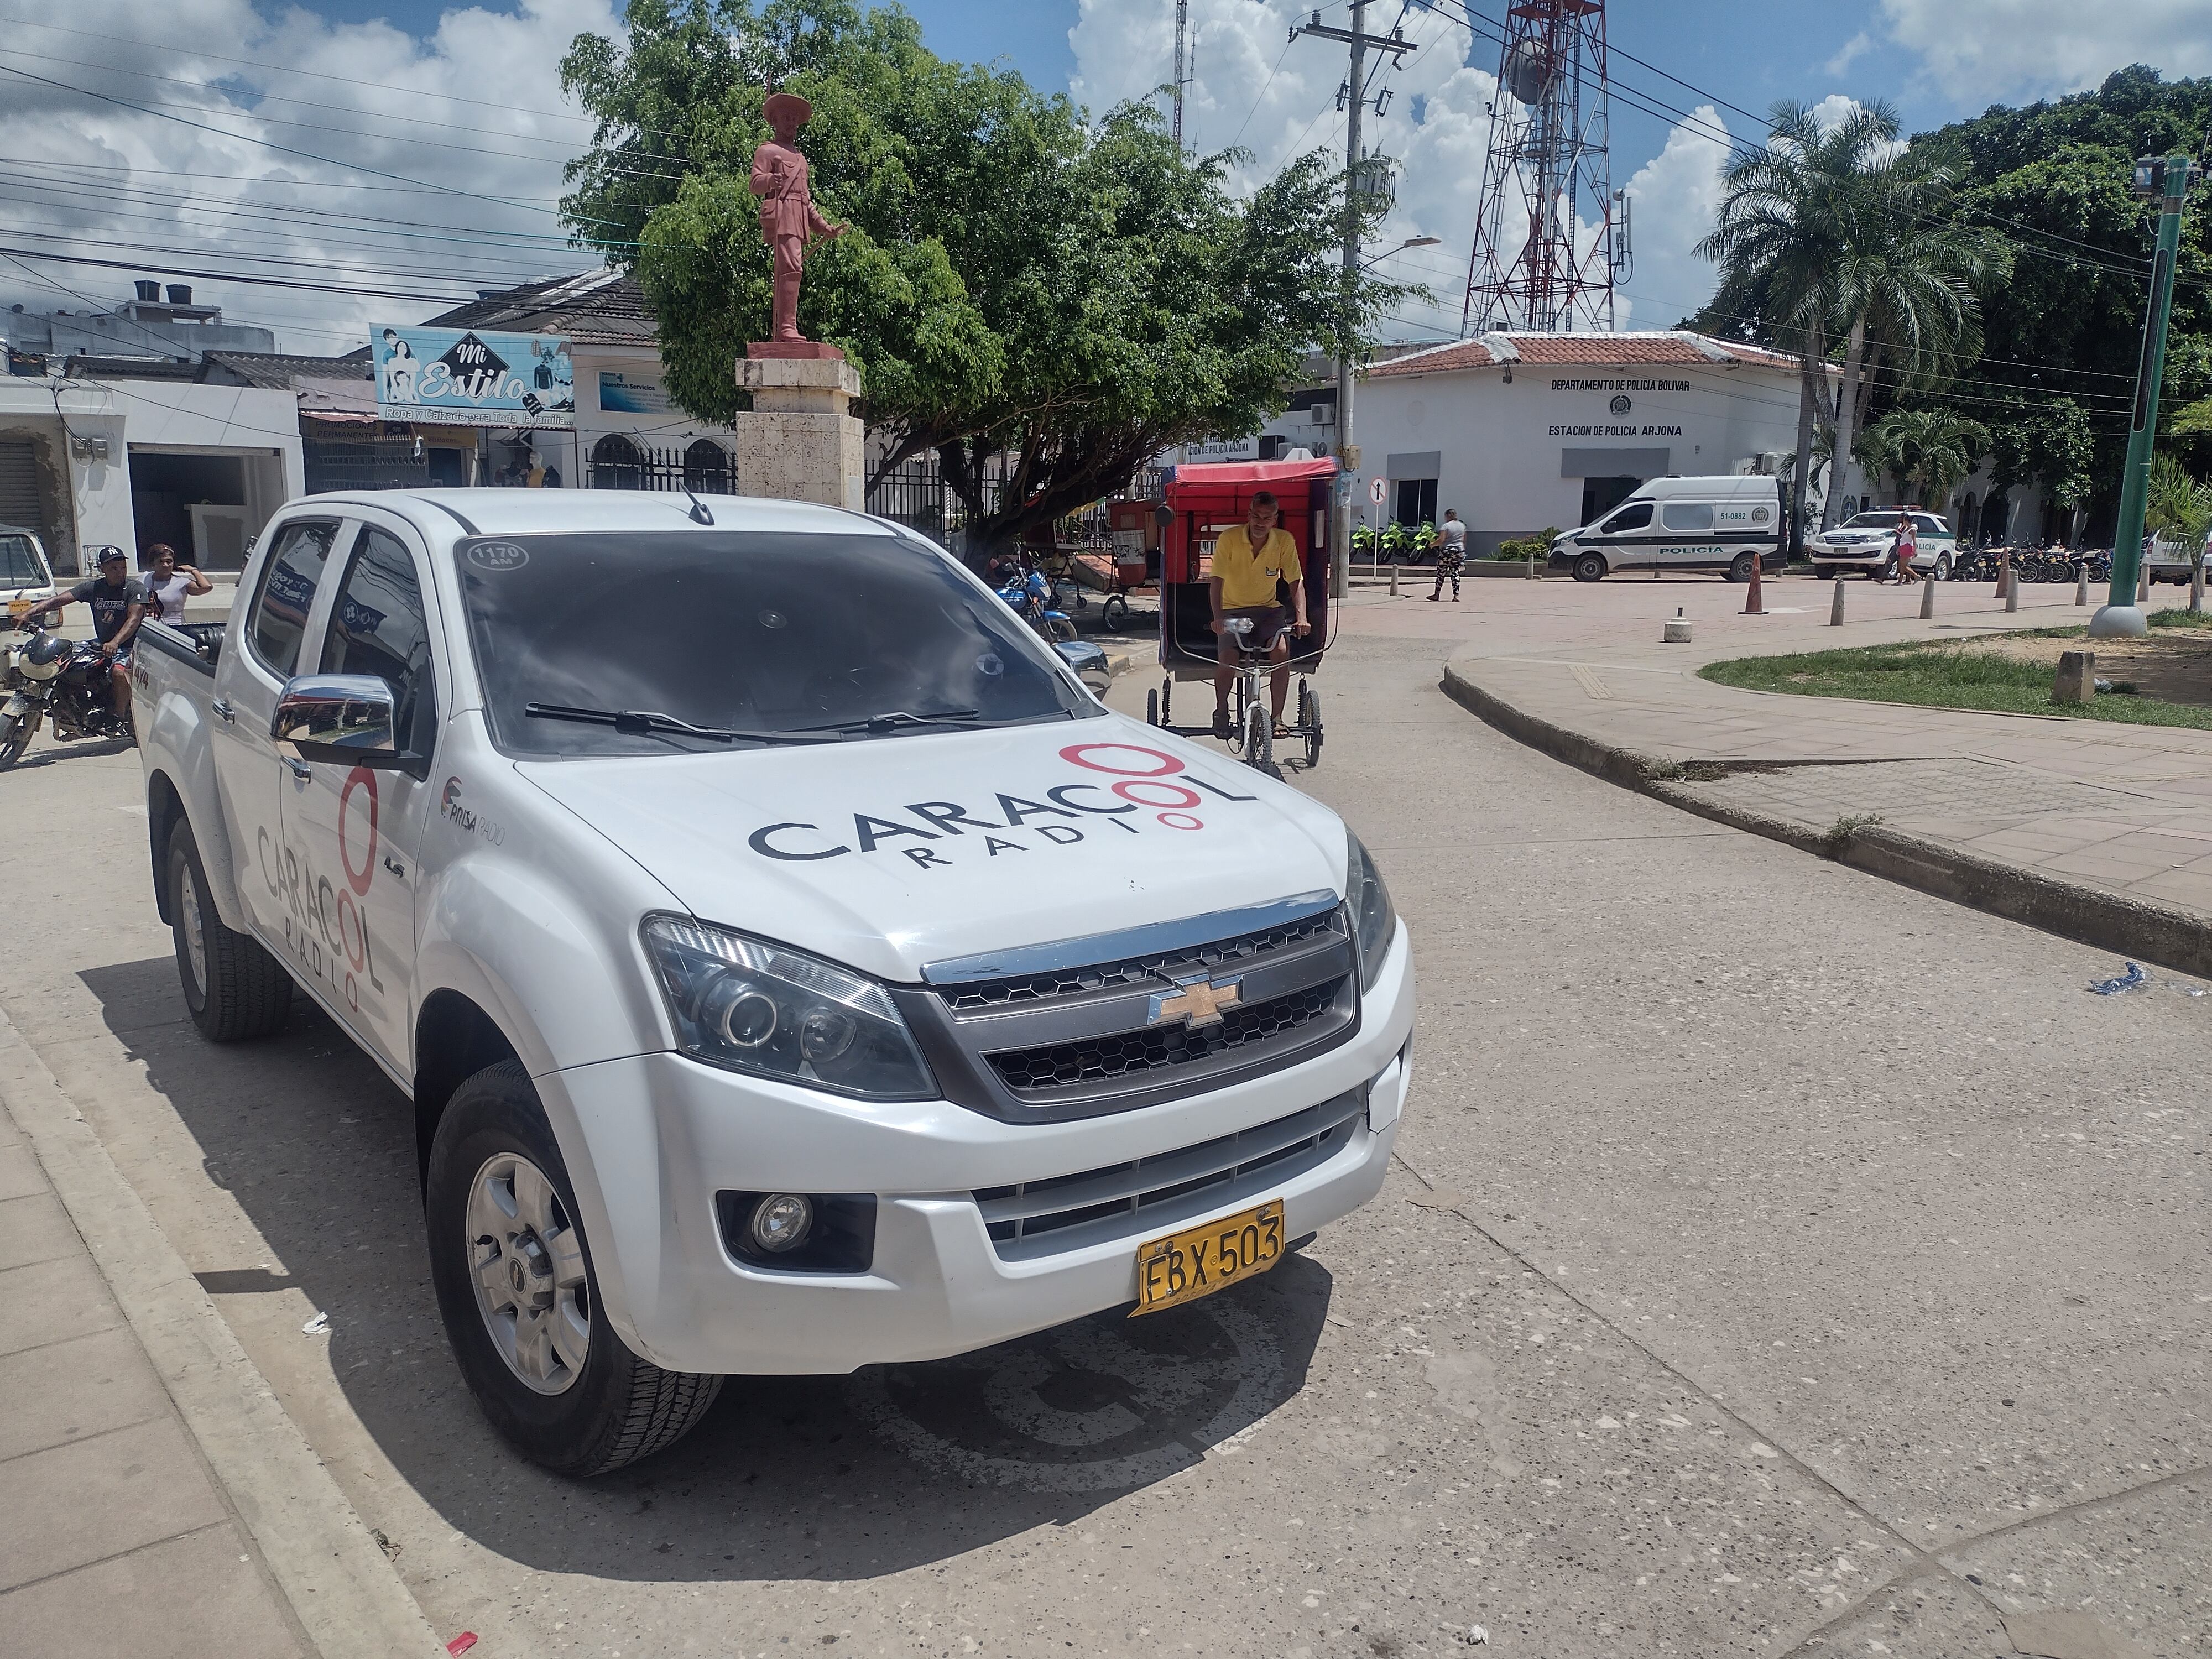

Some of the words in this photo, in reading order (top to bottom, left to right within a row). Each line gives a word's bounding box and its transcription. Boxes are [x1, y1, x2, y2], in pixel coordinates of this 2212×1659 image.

[456, 343, 487, 364] Mi
[418, 362, 530, 399] Estilo
[1551, 379, 1614, 390] DEPARTAMENTO
[1615, 379, 1625, 390] DE
[1626, 379, 1656, 391] POLICIA
[1658, 380, 1690, 392] BOLIVAR
[385, 406, 413, 420] Ropa
[415, 410, 422, 421] y
[468, 413, 491, 424] para
[493, 412, 518, 423] Toda
[521, 414, 532, 424] la
[1548, 425, 1592, 436] ESTACION
[1593, 425, 1603, 436] DE
[1605, 425, 1637, 436] POLICIA
[1641, 425, 1682, 436] ARJONA
[1202, 446, 1208, 455] DE
[1209, 444, 1228, 454] POLICIA
[474, 547, 519, 558] 1170
[1660, 545, 1724, 554] POLICÍA
[748, 773, 1260, 862] CARACOL
[477, 817, 505, 846] RADIO
[901, 812, 1204, 870] RADIO
[258, 825, 384, 998] CARACOL
[285, 916, 358, 1013] RADIO
[1147, 1240, 1208, 1304] FBX
[1220, 1215, 1280, 1277] 503
